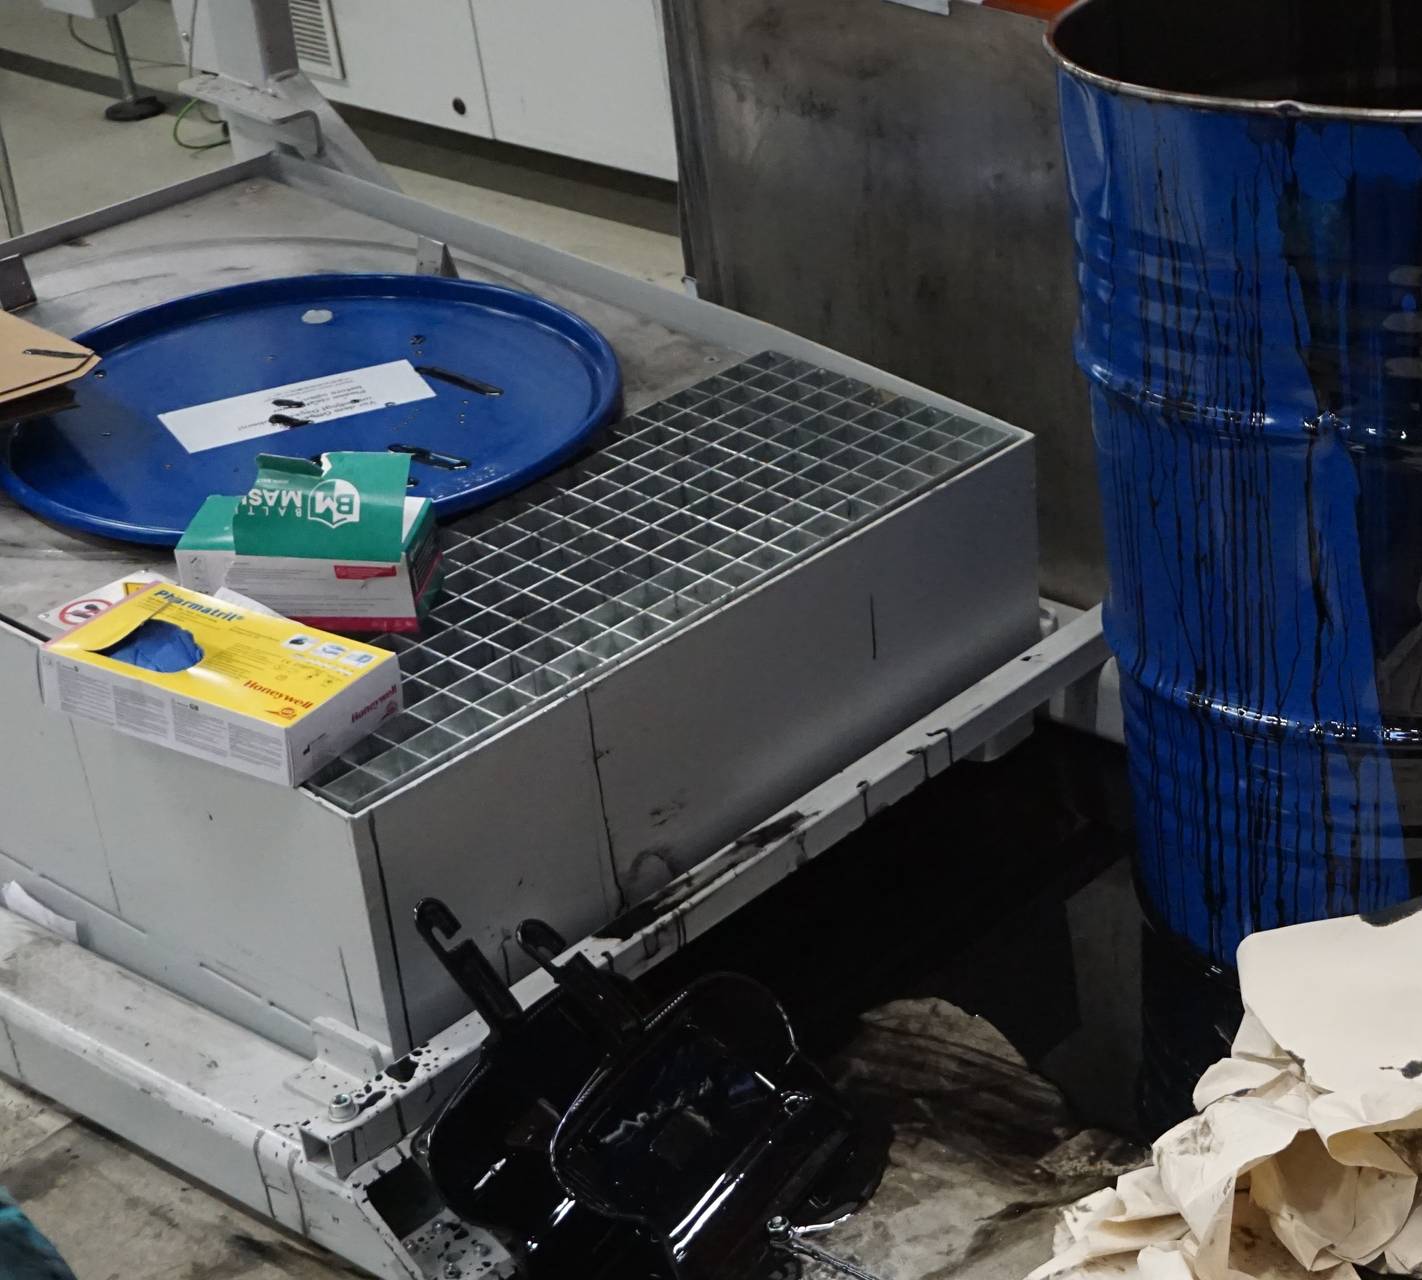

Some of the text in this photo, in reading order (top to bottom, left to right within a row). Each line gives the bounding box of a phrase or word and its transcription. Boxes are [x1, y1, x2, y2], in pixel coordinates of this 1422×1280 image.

[314, 491, 355, 515] BM
[243, 680, 315, 709] Honeywell
[351, 684, 398, 723] Honeywell
